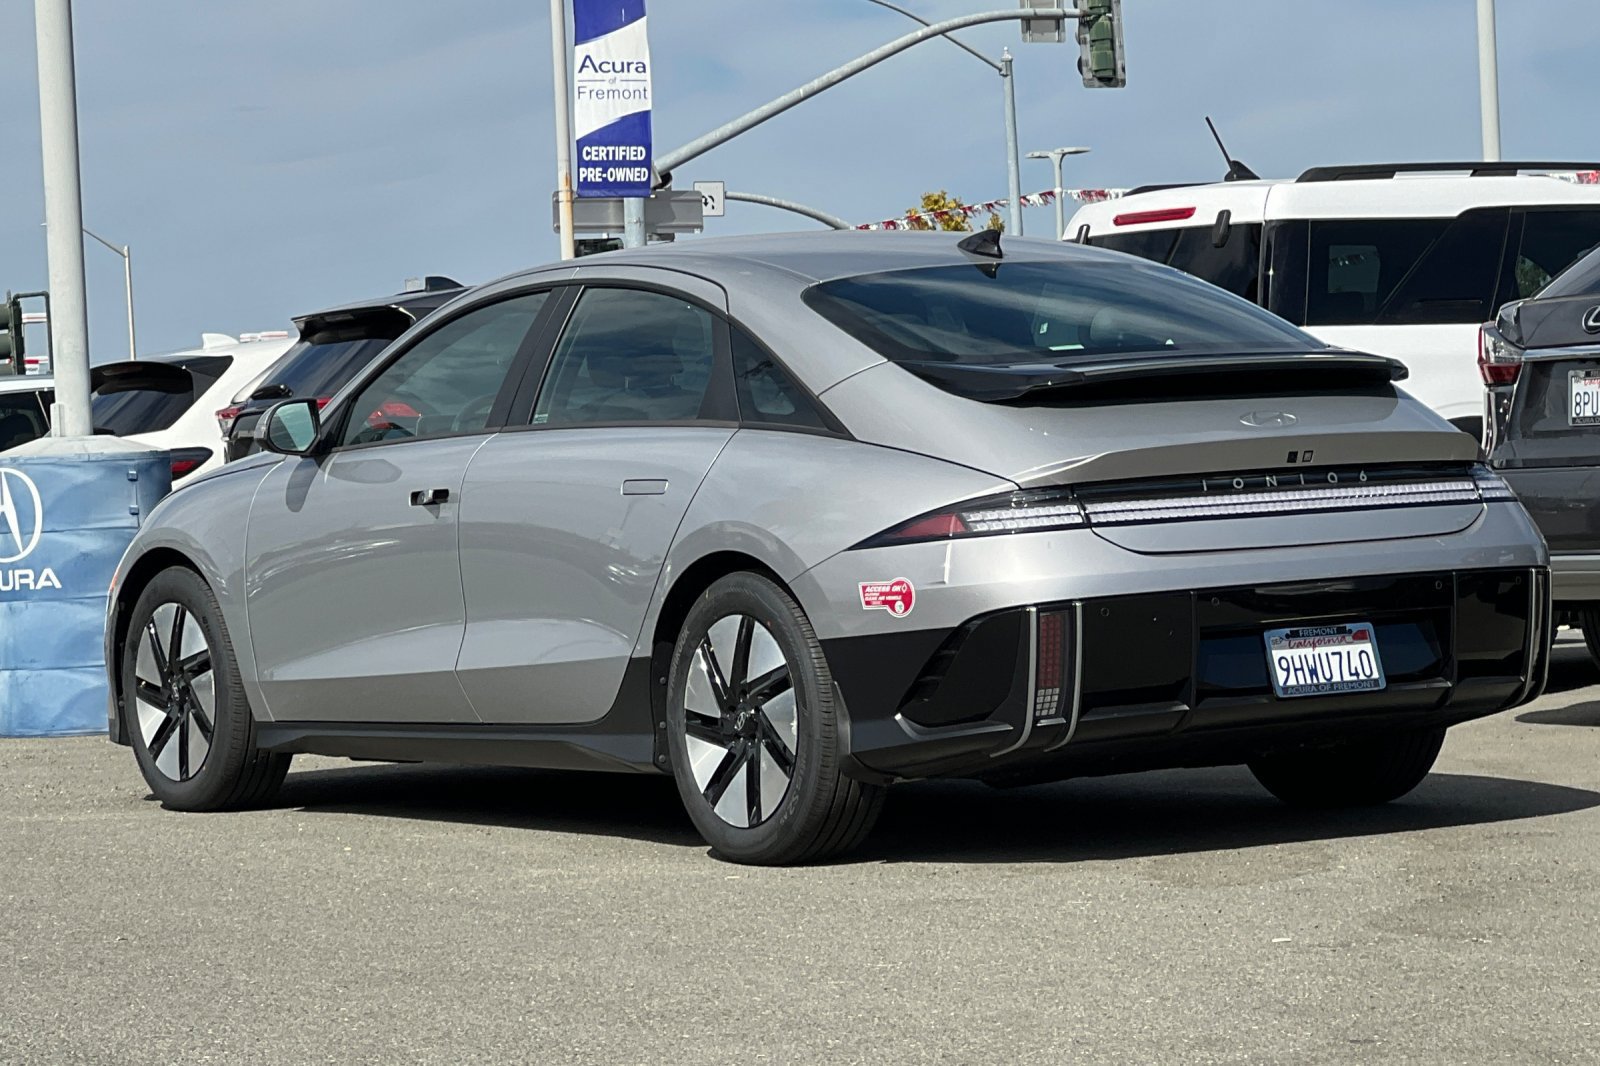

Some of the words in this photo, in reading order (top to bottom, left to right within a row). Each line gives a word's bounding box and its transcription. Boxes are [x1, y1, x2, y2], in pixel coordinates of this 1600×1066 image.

[577, 54, 647, 74] Acura
[608, 76, 617, 85] of
[577, 85, 648, 100] Fremont
[582, 145, 646, 161] CERTIFIED
[579, 167, 649, 182] PRE-OWNED
[1299, 626, 1338, 637] FREMONT
[1288, 635, 1349, 652] California
[1278, 649, 1373, 687] 9HWU740
[1288, 684, 1318, 694] ACURA
[1318, 683, 1331, 692] OF
[1333, 680, 1376, 691] FREMONT
